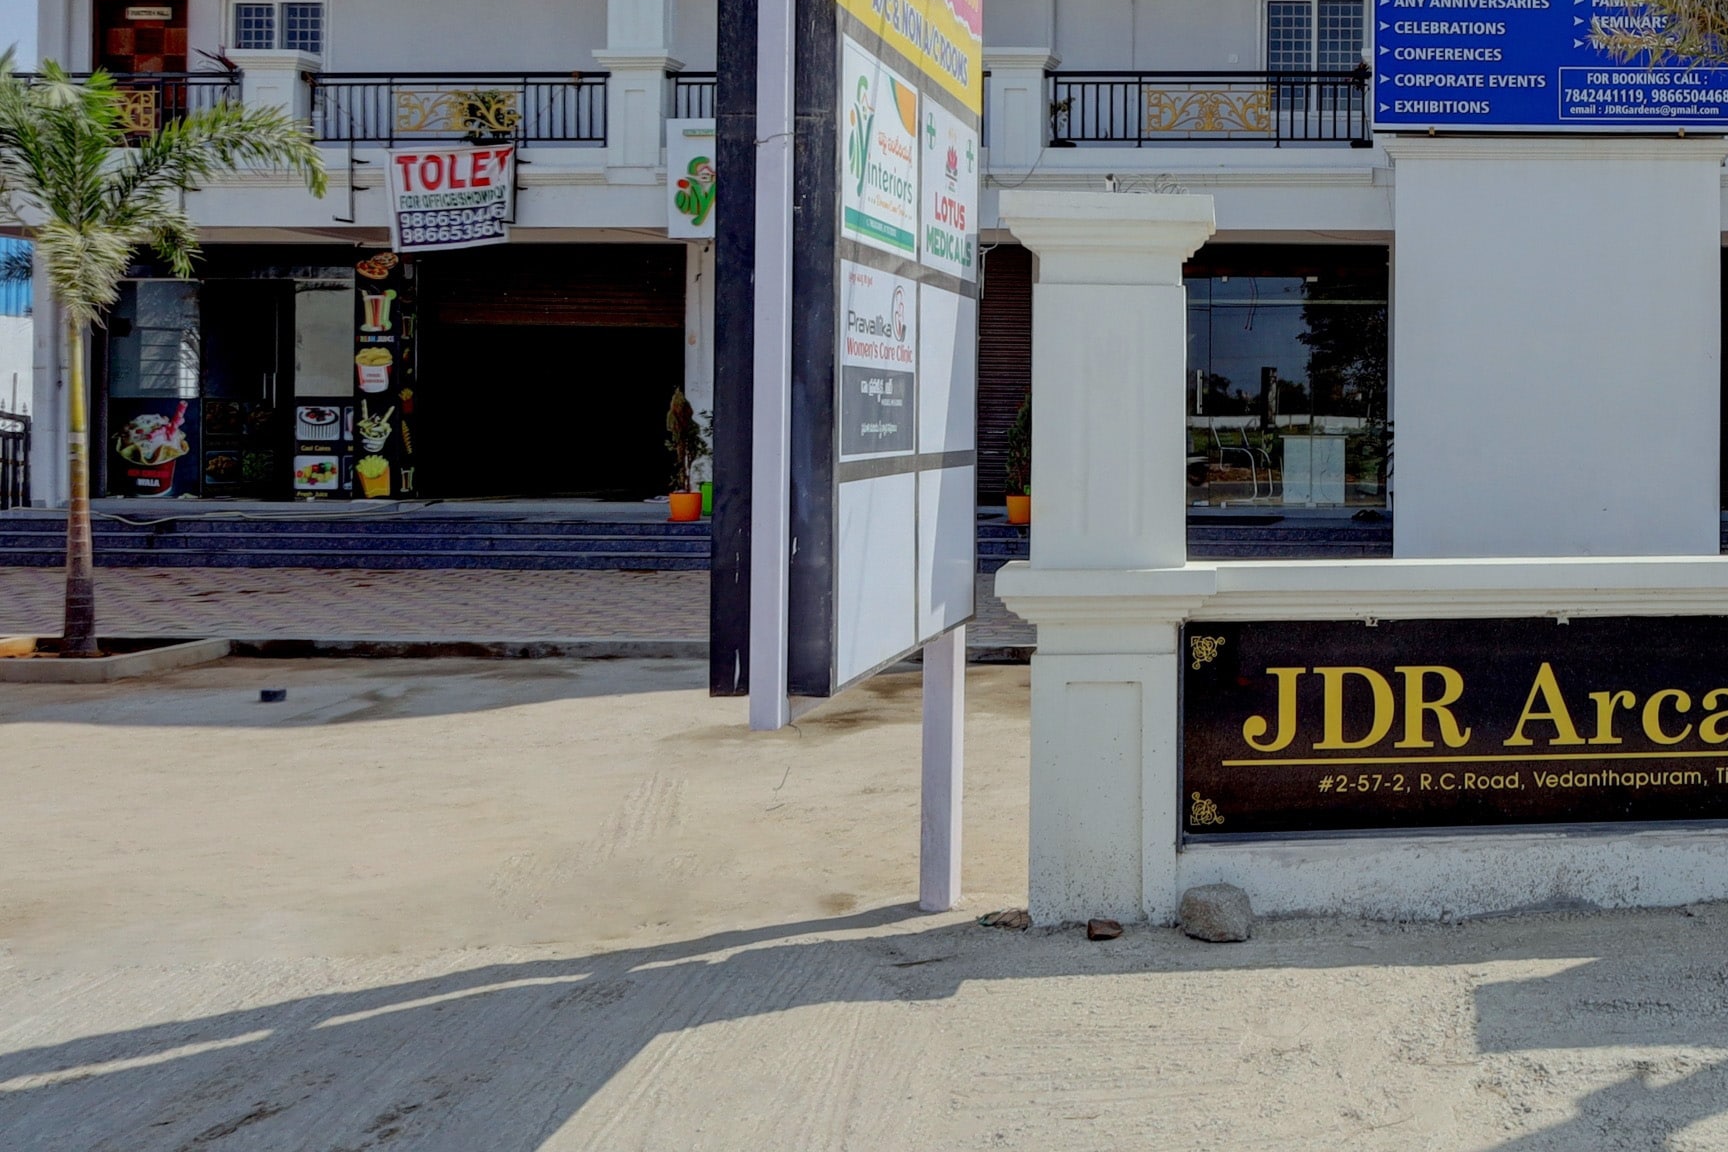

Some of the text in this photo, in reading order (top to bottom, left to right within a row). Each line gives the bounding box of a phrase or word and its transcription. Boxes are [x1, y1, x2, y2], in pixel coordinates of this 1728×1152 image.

[1394, 21, 1506, 35] CELEBRATIONS
[902, 0, 922, 48] NON
[924, 20, 940, 63] A/C
[940, 33, 968, 87] ROOMS
[1394, 48, 1502, 61] CONFERENCES
[1394, 74, 1546, 87] CORPORATE EVENTS
[1587, 73, 1609, 85] FOR
[1612, 73, 1670, 85] BOOKINGS
[1674, 74, 1701, 85] CALL
[1565, 89, 1647, 104] 7842441119,
[1394, 100, 1490, 113] EXHIBITIONS
[1570, 105, 1596, 114] email
[1604, 105, 1719, 117] JDRGardens@gmail.com
[867, 153, 913, 204] interiors
[400, 195, 420, 209] FOR
[935, 192, 965, 231] LOTUS
[926, 224, 972, 267] MEDICALS
[847, 337, 913, 363] Women's Care Clinic
[1242, 664, 1471, 752] JDR
[1318, 772, 1411, 794] #2-57-2,
[1419, 770, 1525, 791] R.C.Road,
[1533, 767, 1708, 789] Vedanthapuram,
